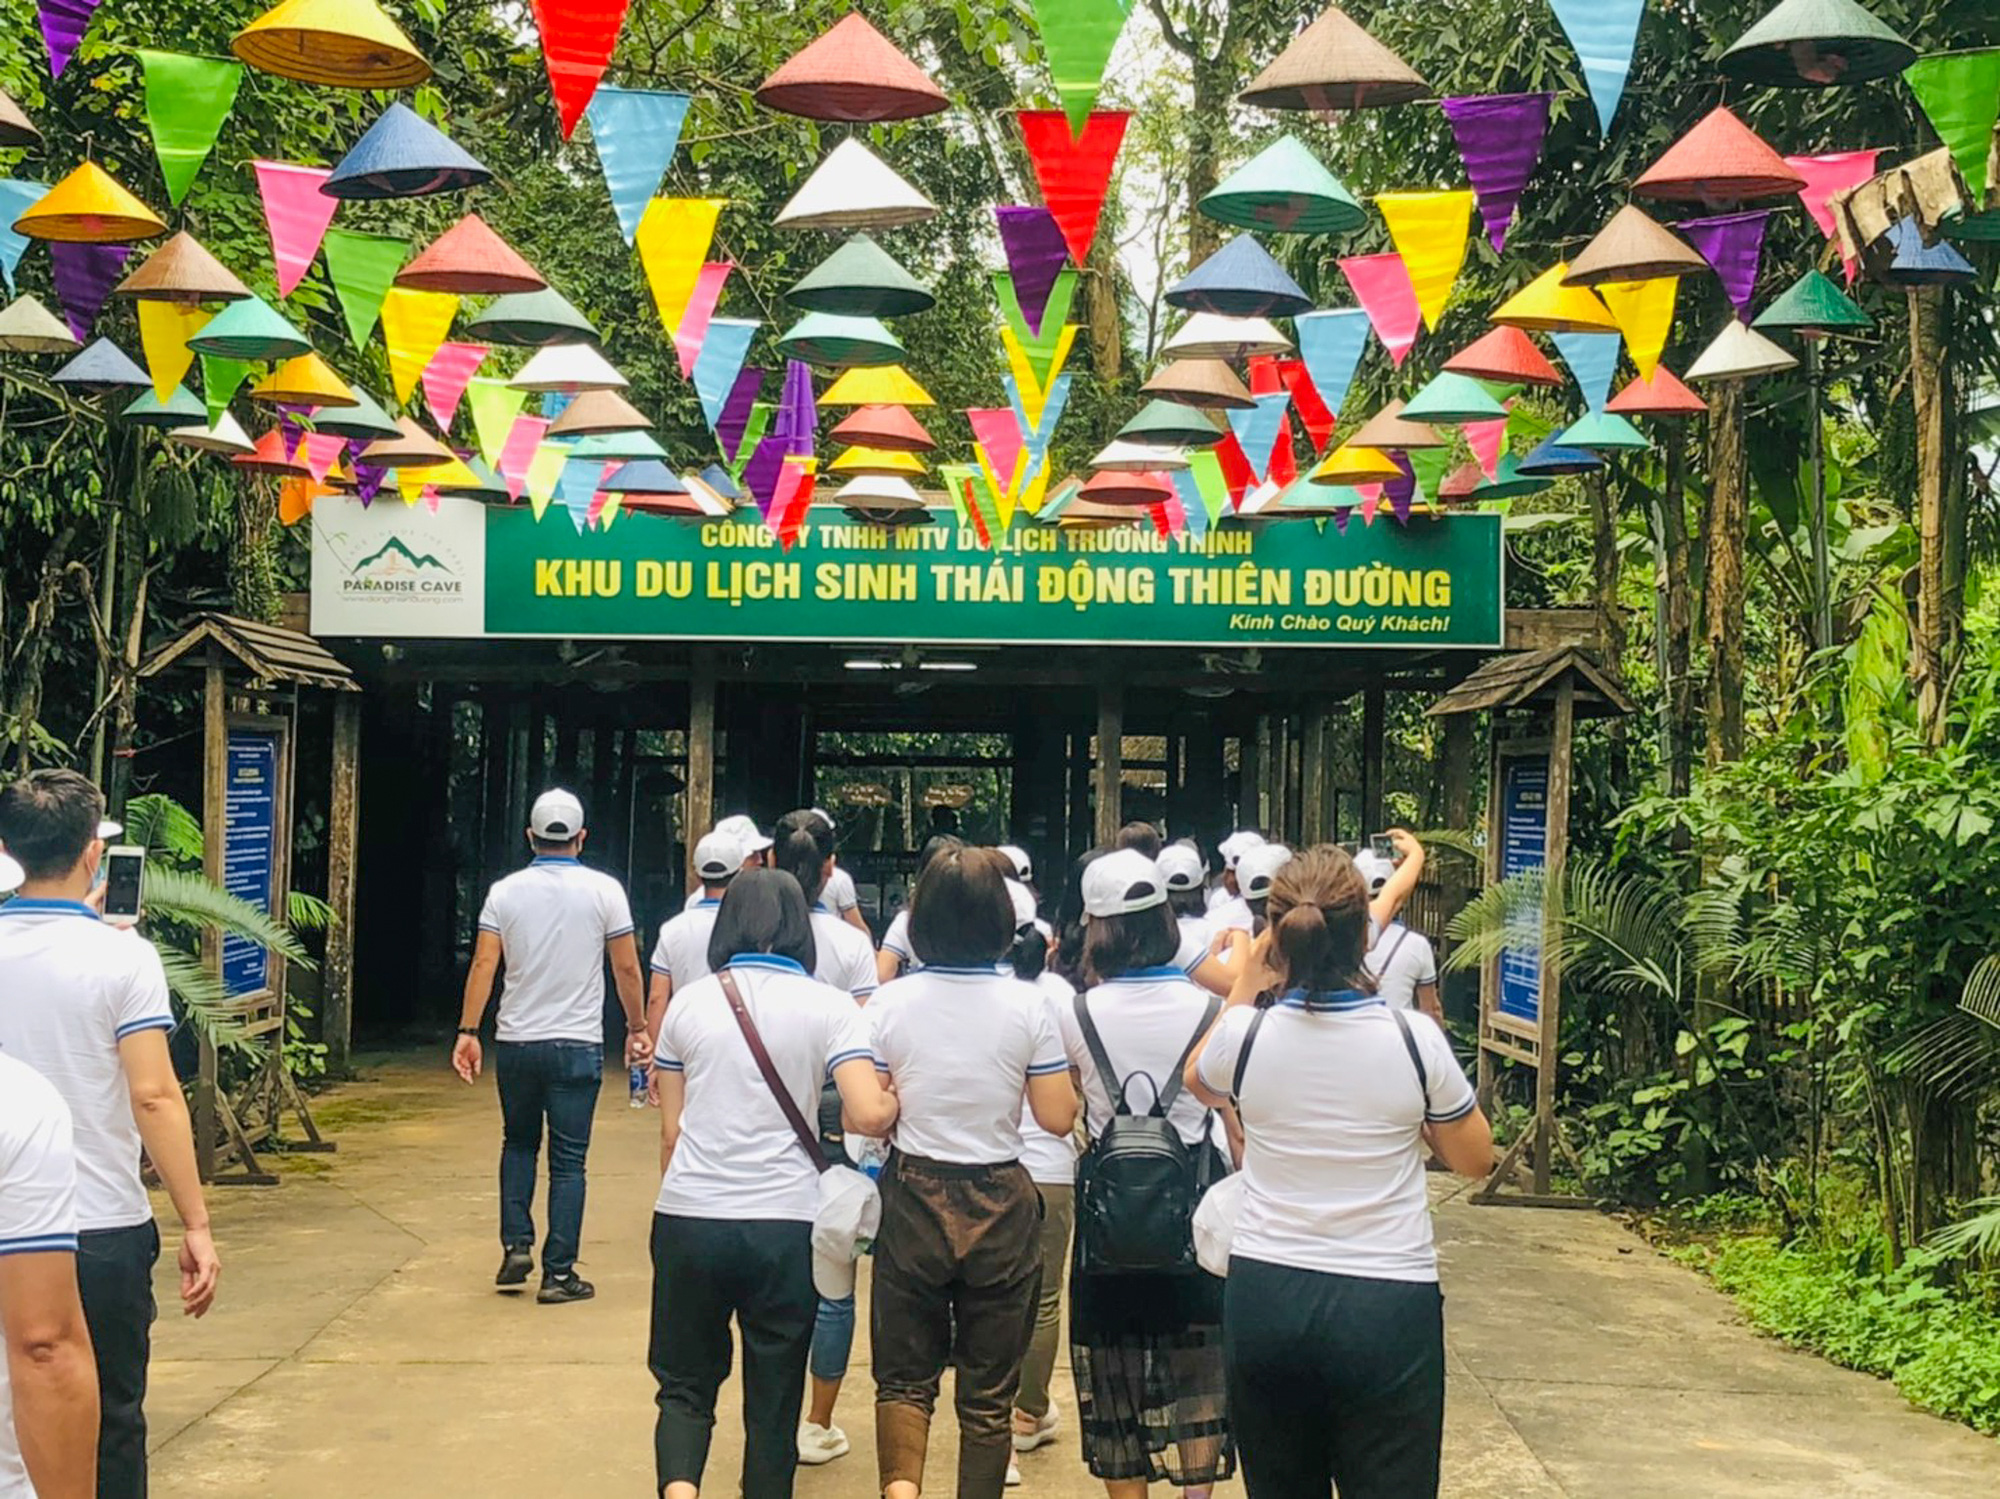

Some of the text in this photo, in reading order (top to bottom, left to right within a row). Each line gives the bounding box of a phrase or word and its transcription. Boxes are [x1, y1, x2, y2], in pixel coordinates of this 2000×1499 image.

[701, 519, 774, 548] CÔNG
[818, 525, 888, 550] TNHH
[895, 527, 950, 551] MTV
[998, 528, 1058, 557] LỊCH
[1064, 524, 1168, 553] TRƯỜNG
[1177, 530, 1253, 559] THỊNH
[343, 580, 463, 593] PARADISE CAVE
[534, 558, 1451, 611] KHU DU LỊCH SINH THÁI ĐỘNG THIÊN ĐƯỜNG
[1229, 613, 1451, 635] Kính Chào Quý Khách!
